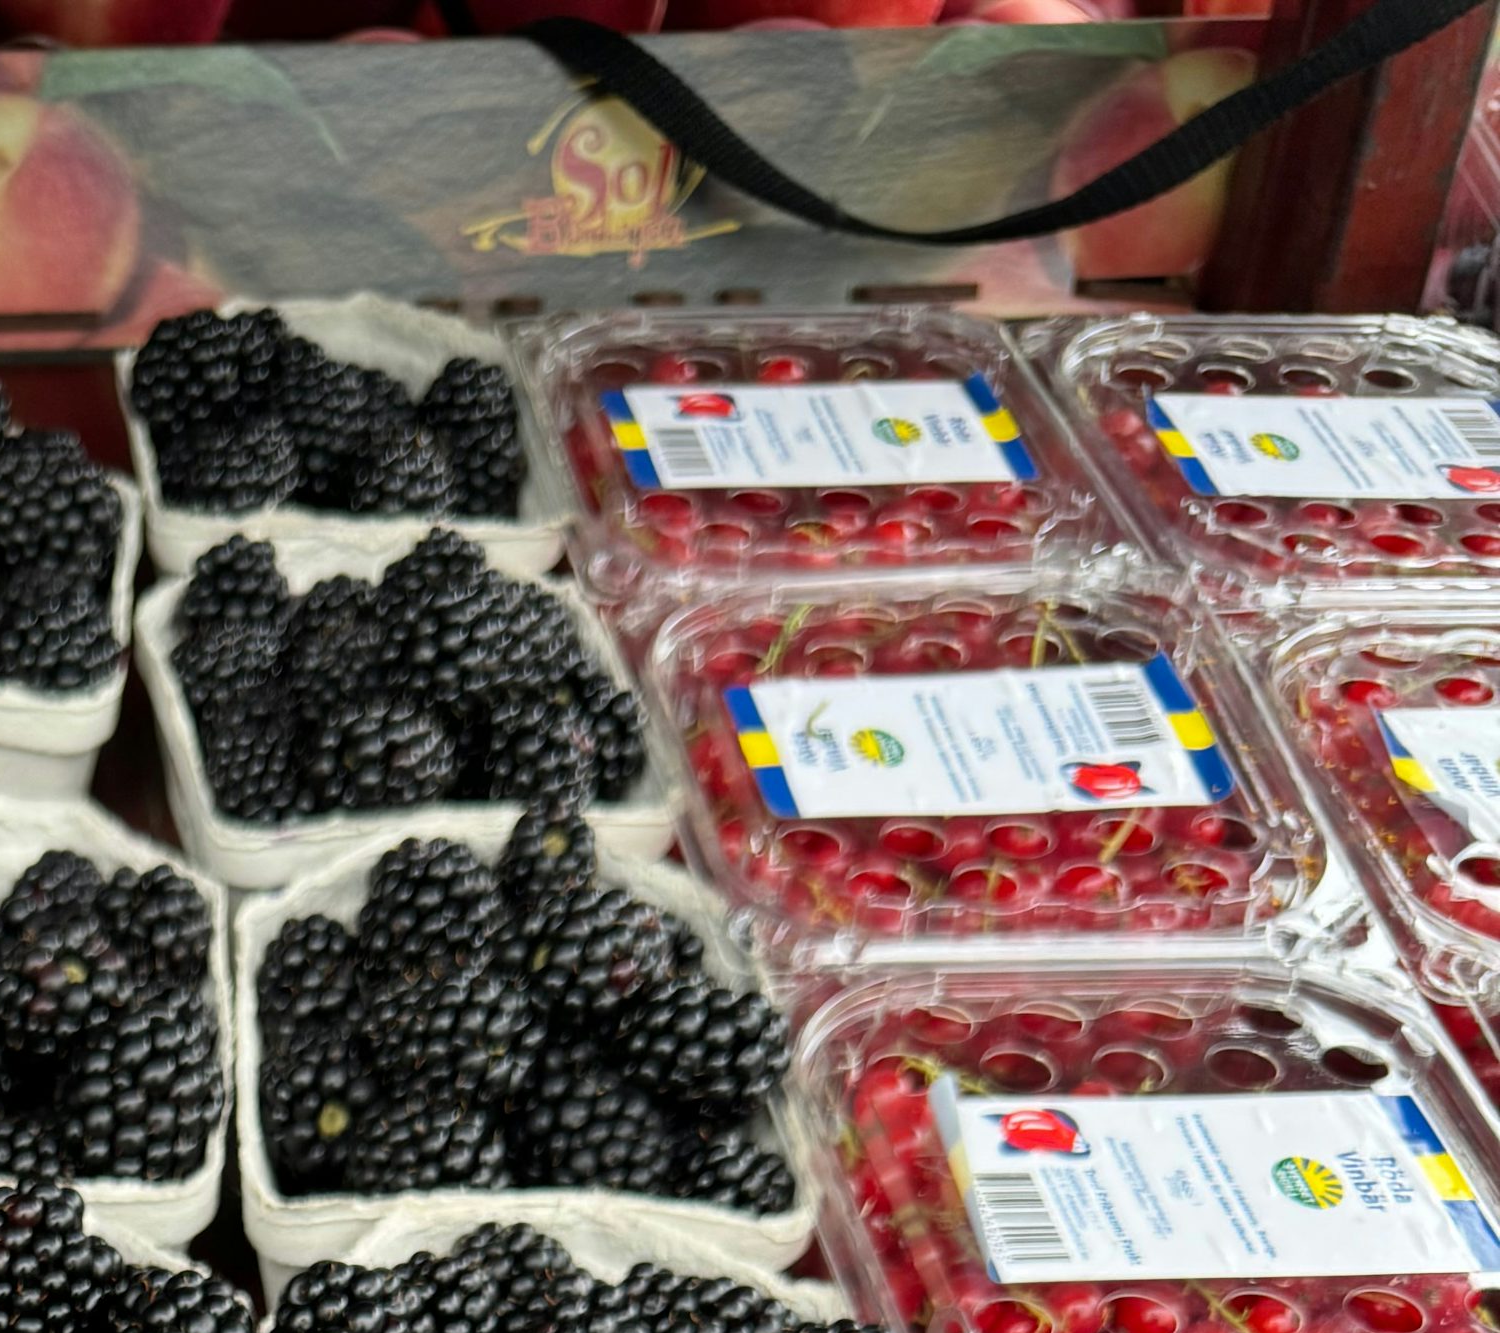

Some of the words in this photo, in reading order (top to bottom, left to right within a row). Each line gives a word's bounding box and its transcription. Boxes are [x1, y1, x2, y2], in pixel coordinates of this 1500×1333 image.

[559, 123, 676, 232] Sol
[1336, 1151, 1388, 1212] Vinbär
[1369, 1156, 1414, 1203] Röda
